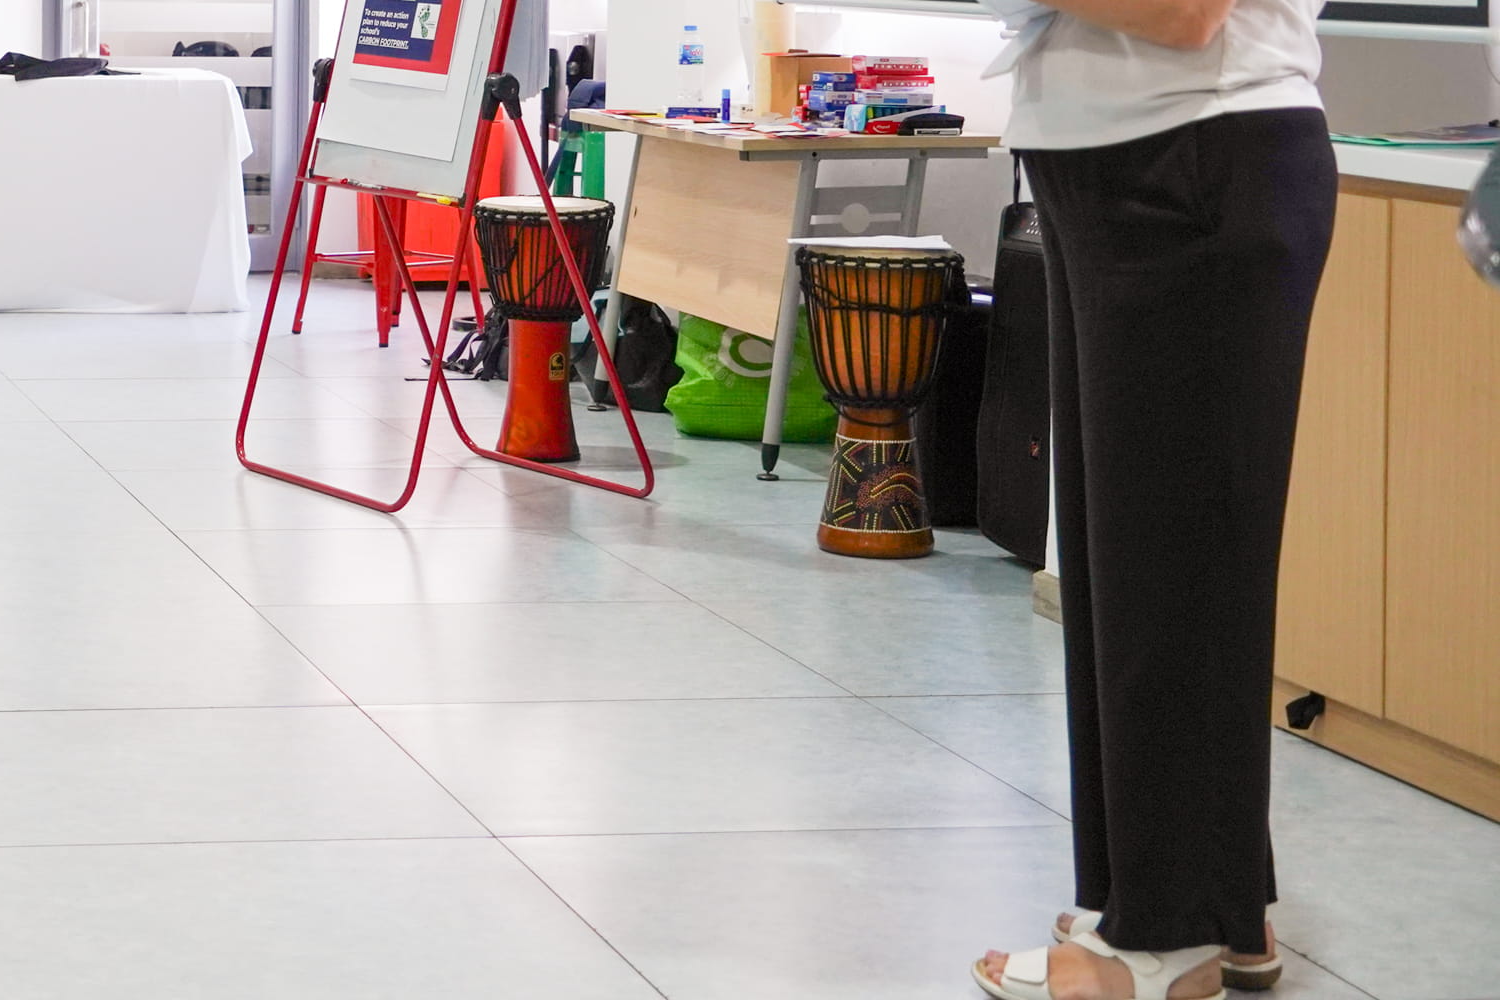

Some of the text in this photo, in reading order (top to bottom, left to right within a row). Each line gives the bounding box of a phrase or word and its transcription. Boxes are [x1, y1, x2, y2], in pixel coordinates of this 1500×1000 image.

[371, 10, 386, 18] create
[394, 11, 409, 20] action
[362, 18, 373, 27] plan
[380, 19, 396, 28] reduce
[396, 22, 408, 30] your
[360, 27, 380, 36] school's
[358, 36, 380, 46] CARBON
